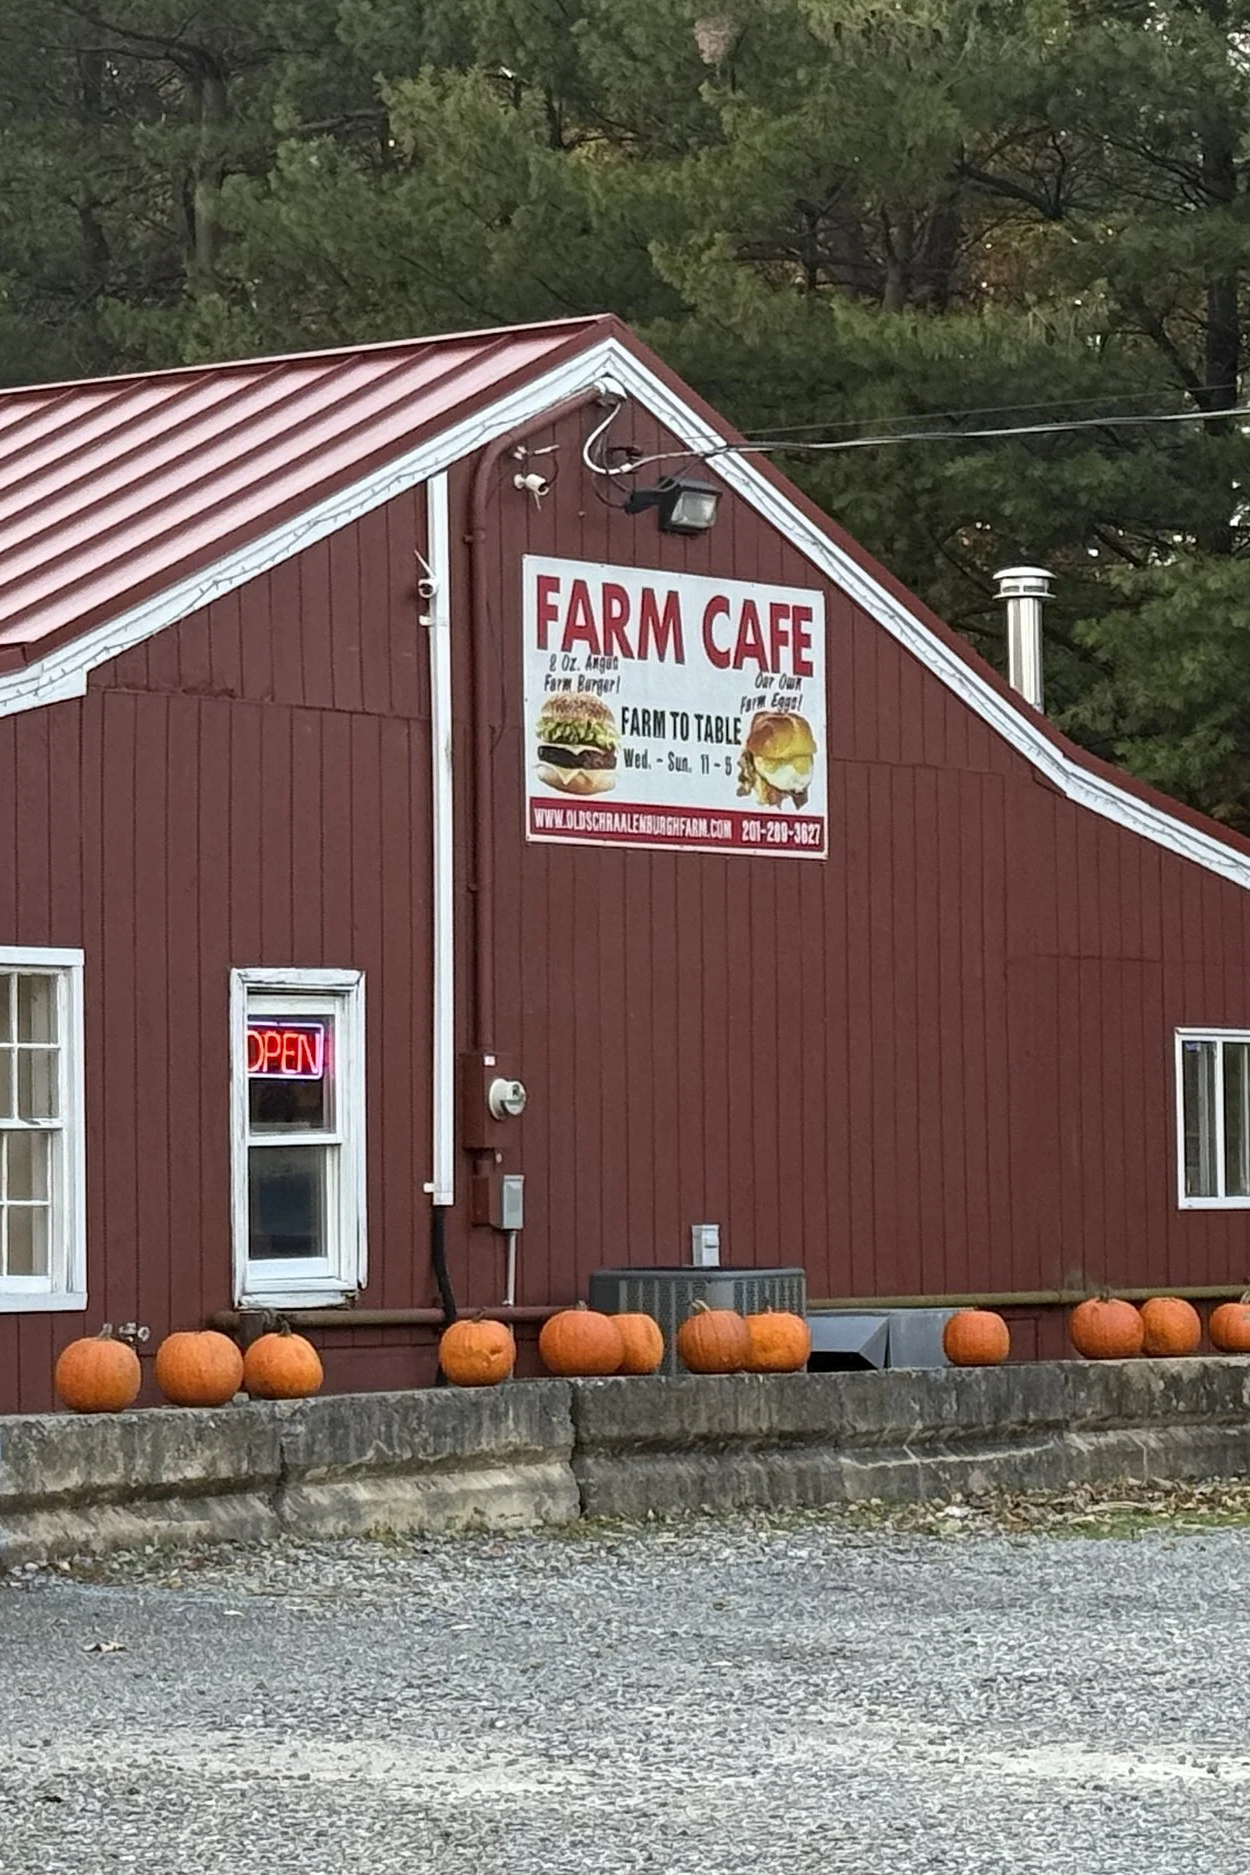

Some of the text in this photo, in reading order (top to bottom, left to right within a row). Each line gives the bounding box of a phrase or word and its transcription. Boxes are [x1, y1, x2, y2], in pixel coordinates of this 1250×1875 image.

[535, 575, 814, 678] FARM CAFE
[585, 654, 619, 674] Angus
[544, 673, 621, 696] Farm Burger!
[754, 672, 803, 691] Our Own
[739, 695, 767, 715] Farm
[621, 706, 742, 746] FARM TO TABLE
[623, 748, 653, 770] Wed.
[667, 751, 693, 773] Sun.
[700, 754, 710, 775] 11
[724, 756, 733, 777] 5
[246, 1030, 321, 1074] OPEN
